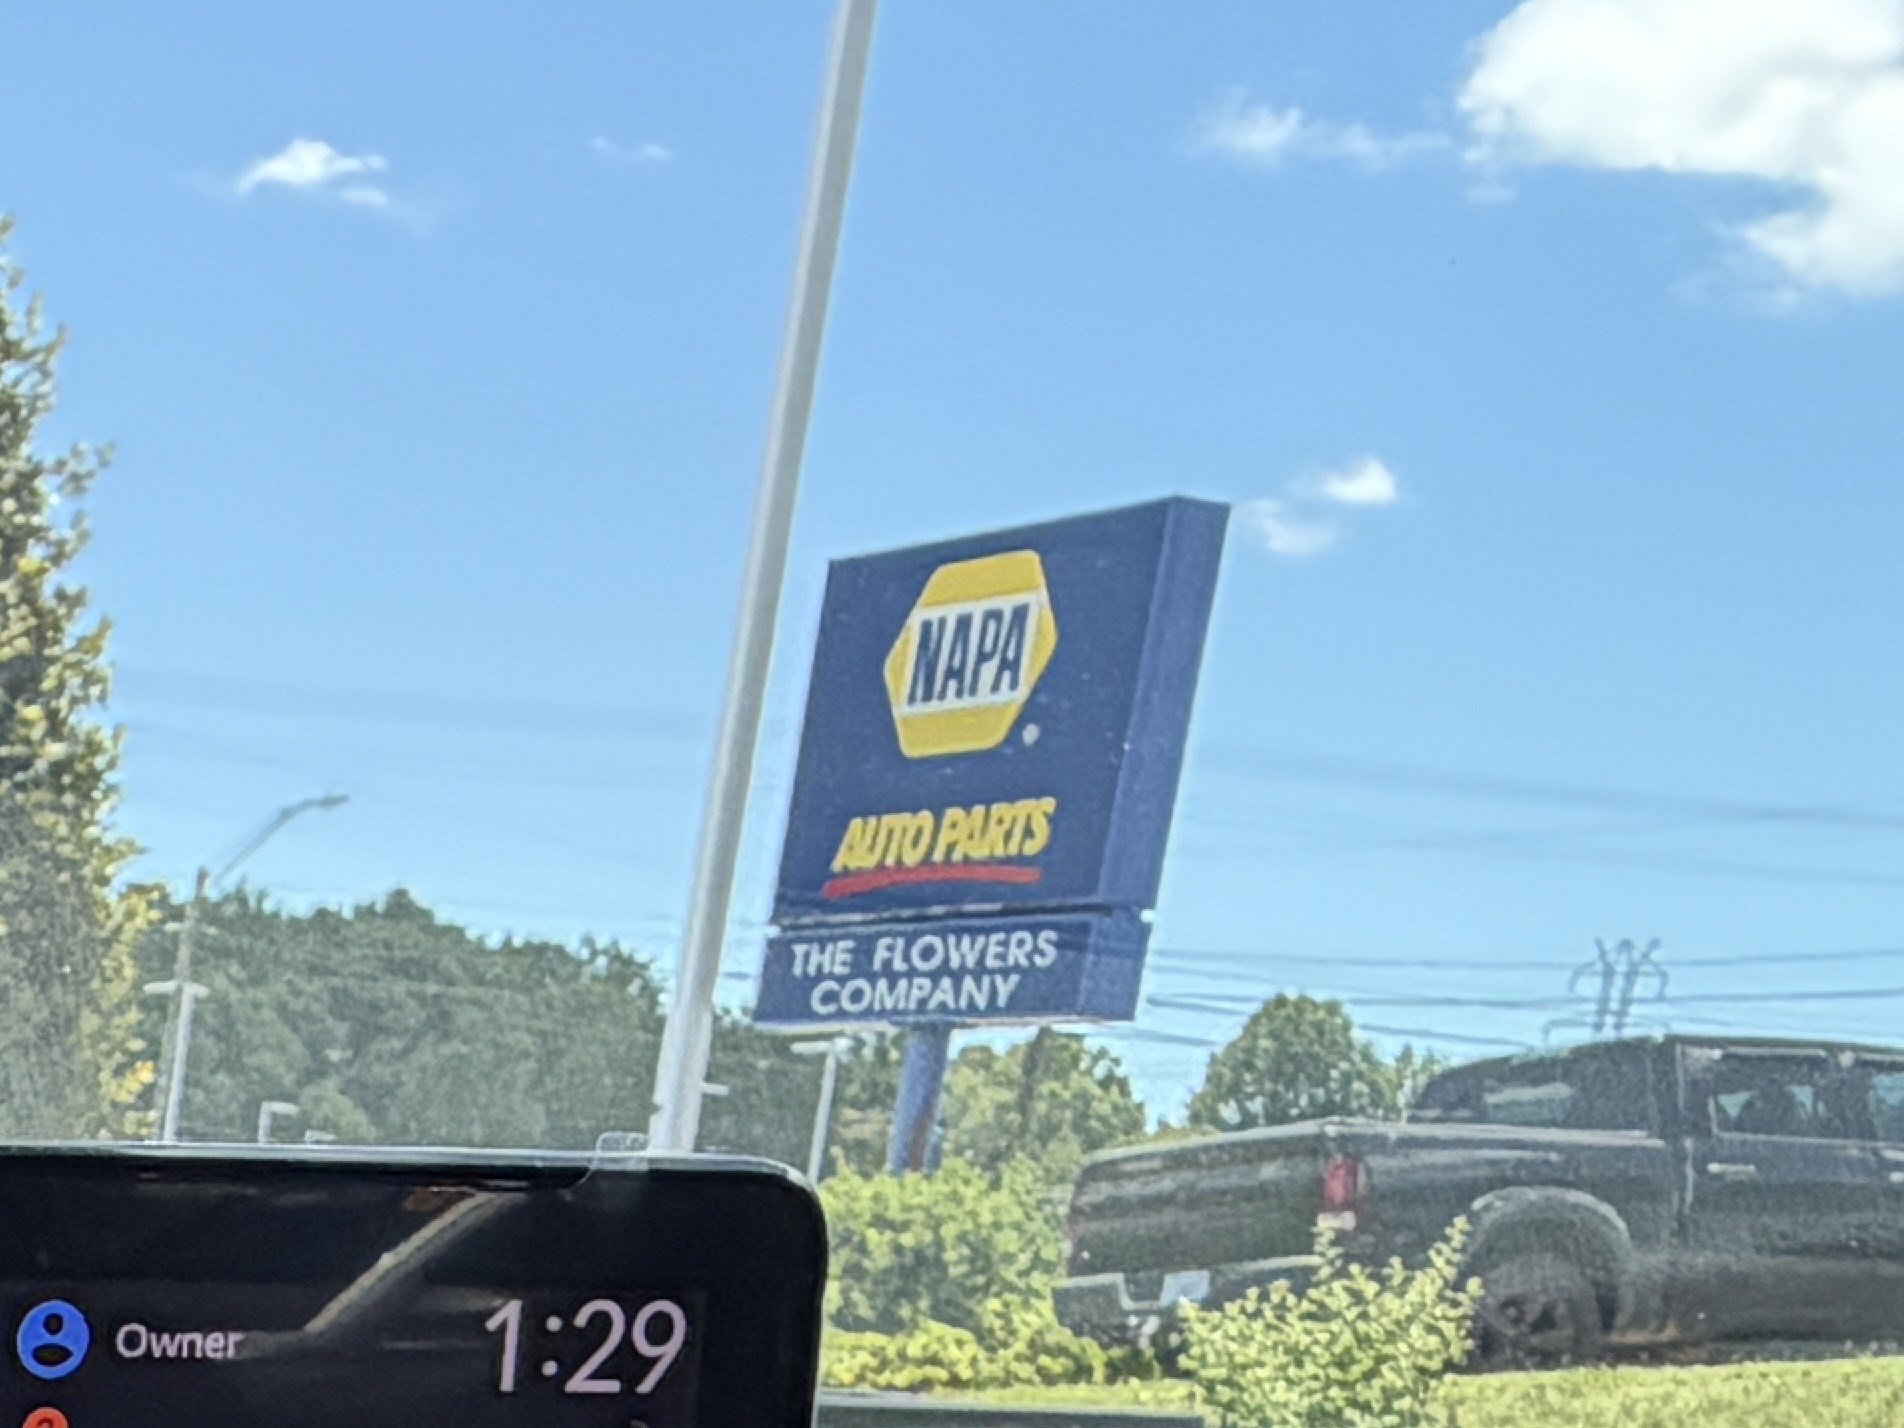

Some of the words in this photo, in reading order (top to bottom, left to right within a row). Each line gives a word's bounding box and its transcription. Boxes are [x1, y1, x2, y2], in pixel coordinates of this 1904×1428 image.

[907, 602, 1031, 706] NAPA
[831, 810, 932, 871] AUTO
[933, 797, 1056, 864] PARTS
[792, 940, 854, 977] THE
[872, 931, 1058, 971] FLOWERS
[810, 975, 1020, 1015] COMPANY
[116, 1324, 244, 1359] Owner
[485, 1299, 686, 1393] 1:29
